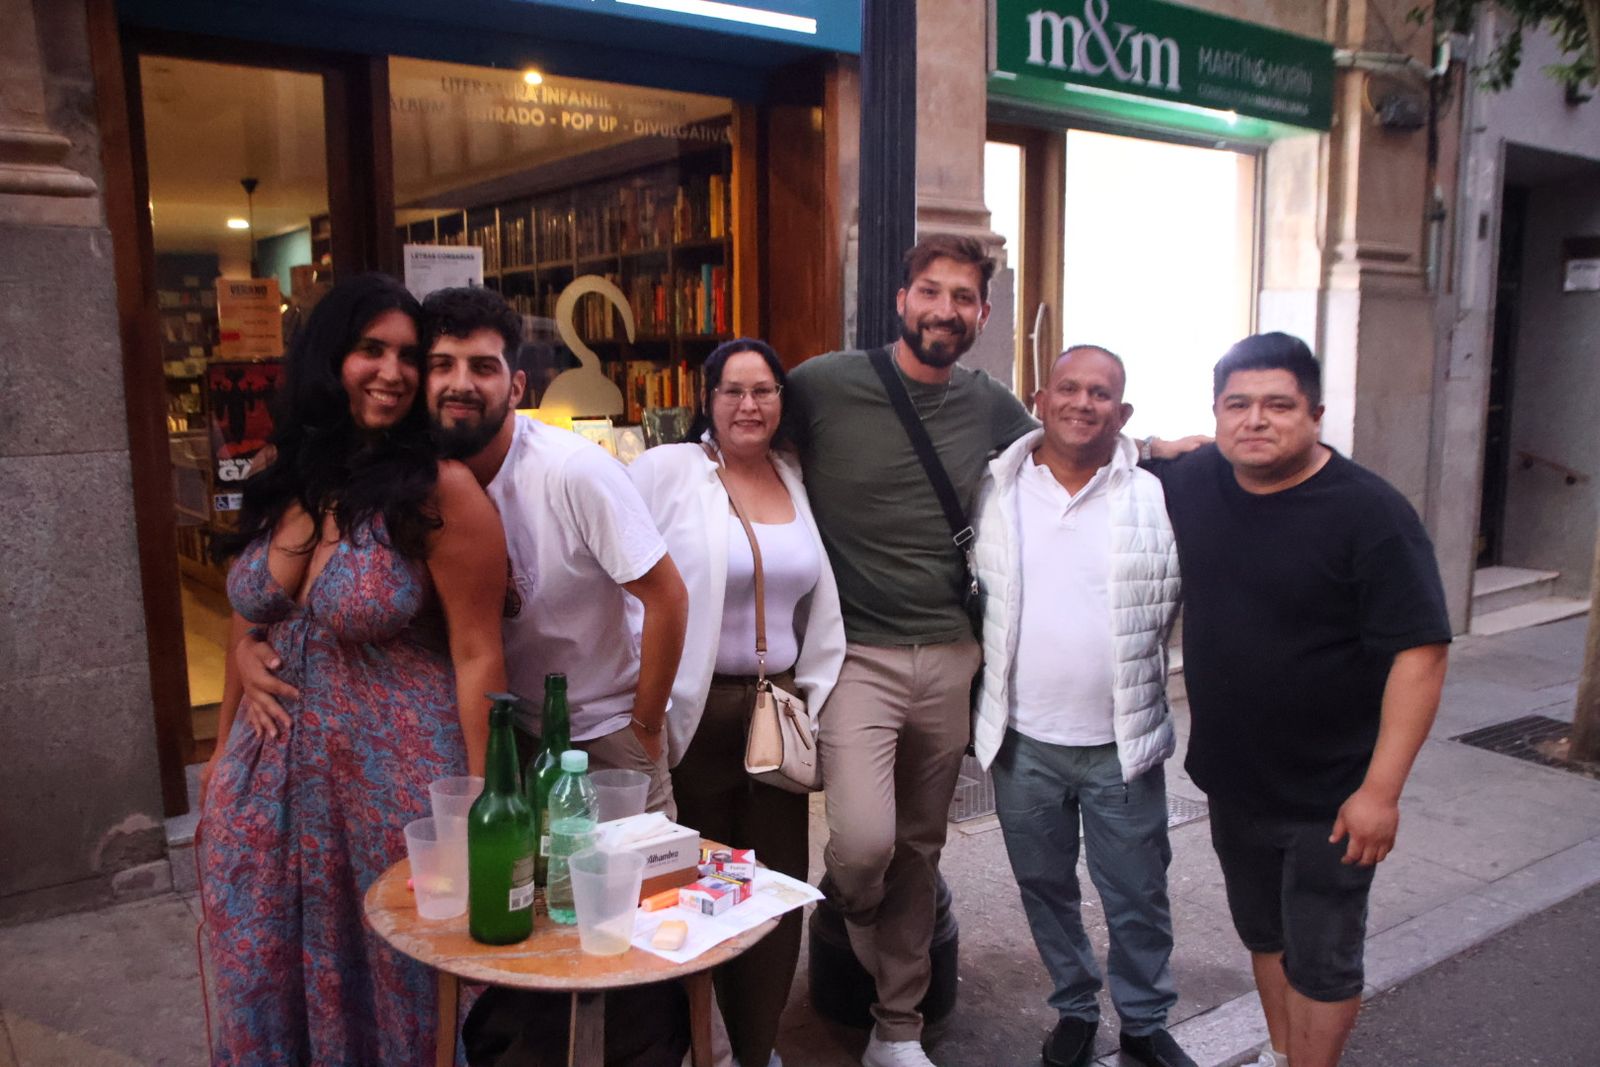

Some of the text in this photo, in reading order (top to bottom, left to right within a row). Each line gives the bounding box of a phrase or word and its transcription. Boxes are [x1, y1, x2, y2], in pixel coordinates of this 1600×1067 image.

[1025, 0, 1182, 93] m&m
[541, 86, 611, 109] INFANTIL
[561, 110, 594, 131] POP
[598, 115, 619, 133] UP
